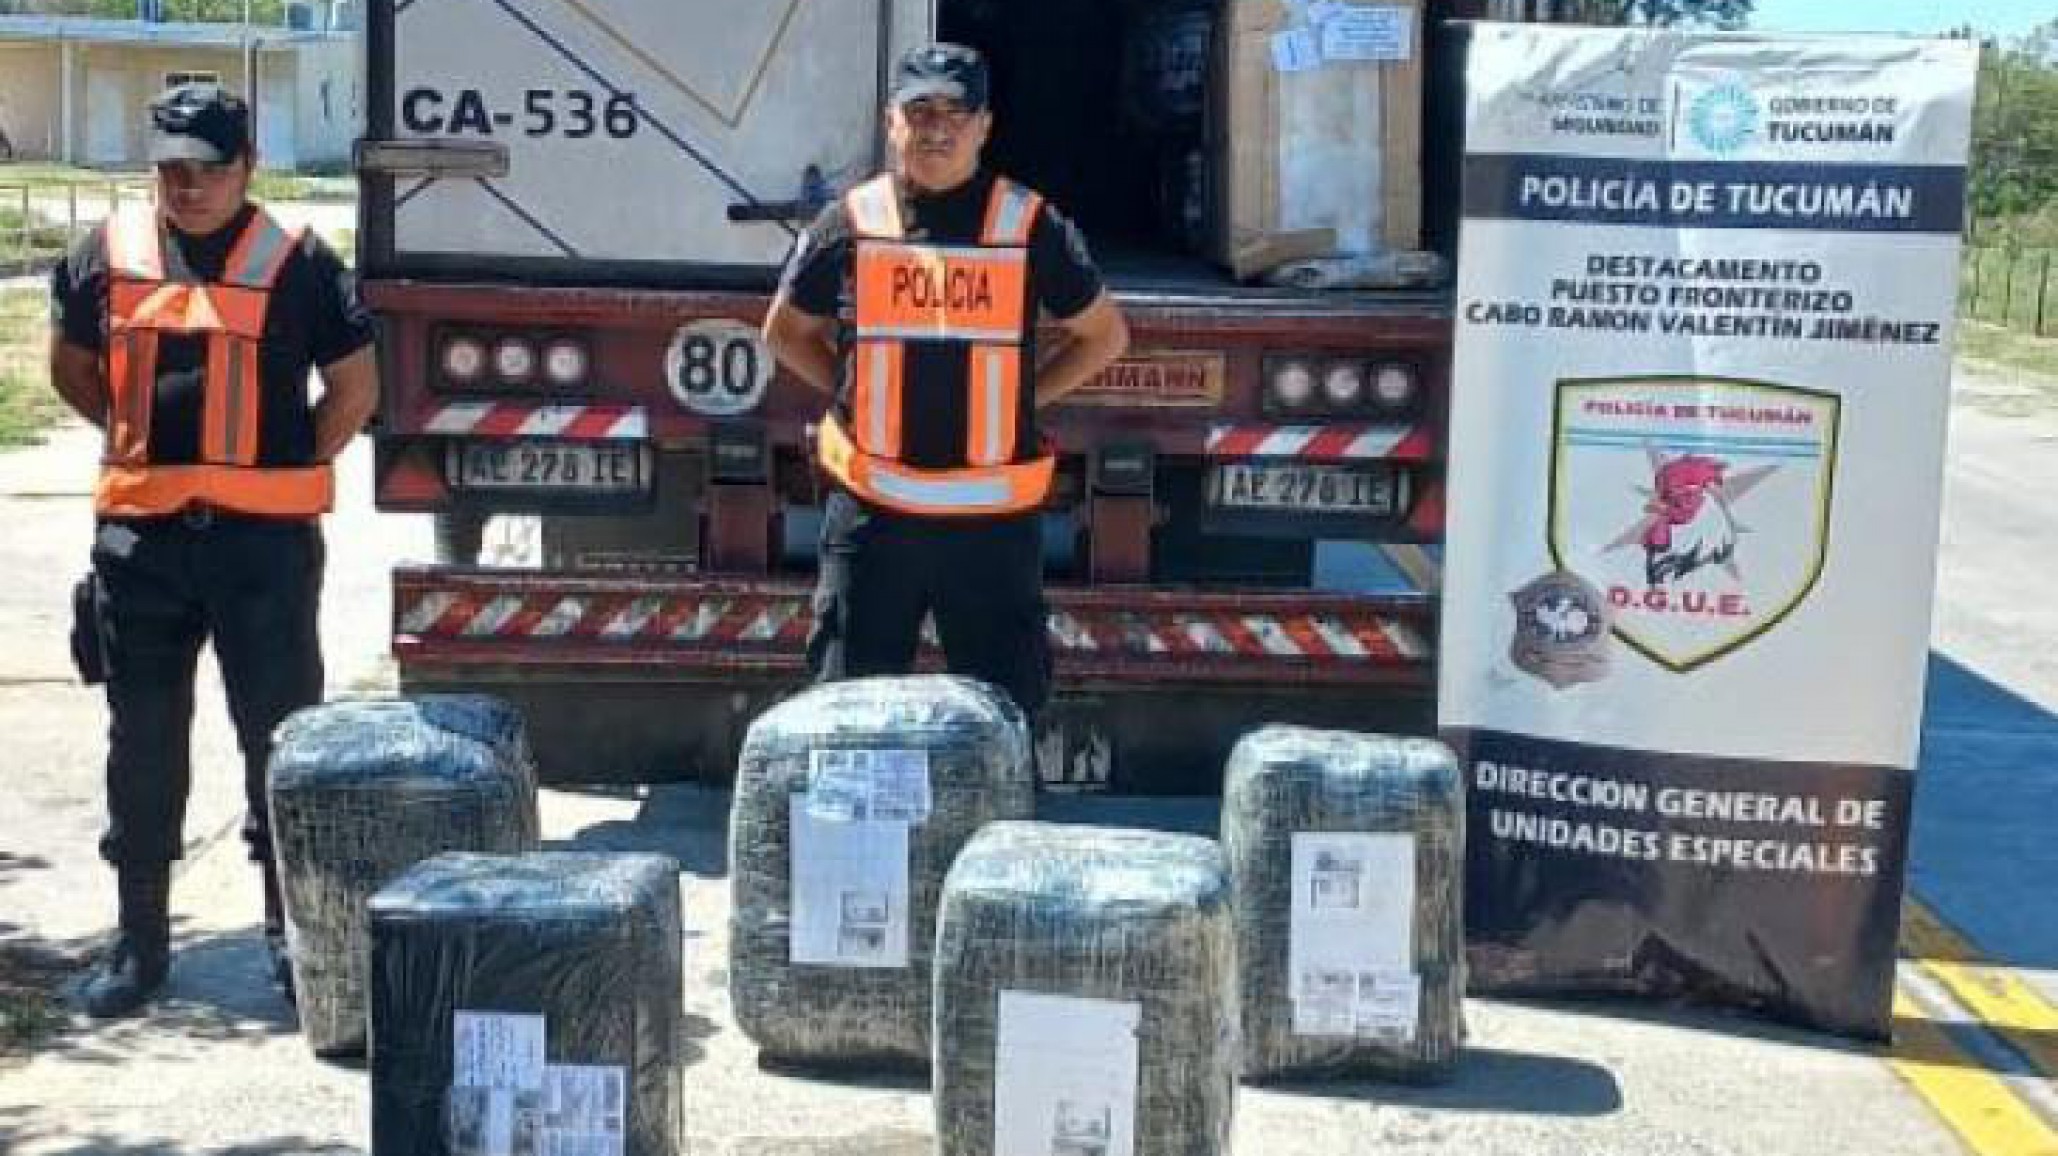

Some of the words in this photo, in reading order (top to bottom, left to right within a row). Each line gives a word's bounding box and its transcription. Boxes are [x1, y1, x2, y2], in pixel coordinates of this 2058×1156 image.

[402, 87, 637, 138] CA-536
[1521, 176, 1658, 209] POLICÍA
[1671, 180, 1715, 213] DE
[1726, 179, 1913, 218] TUCUMÁN
[1587, 255, 1821, 283] DESTACAMENTO
[1466, 302, 1540, 325] CABO
[1553, 279, 1660, 305] PUESTO
[1667, 285, 1852, 312] FRONTERIZO
[679, 335, 758, 395] 80
[1655, 788, 1825, 826] GENERAL
[1836, 797, 1886, 829] DE
[1491, 808, 1661, 860] UNIDADES
[1669, 833, 1878, 876] ESPECIALES
